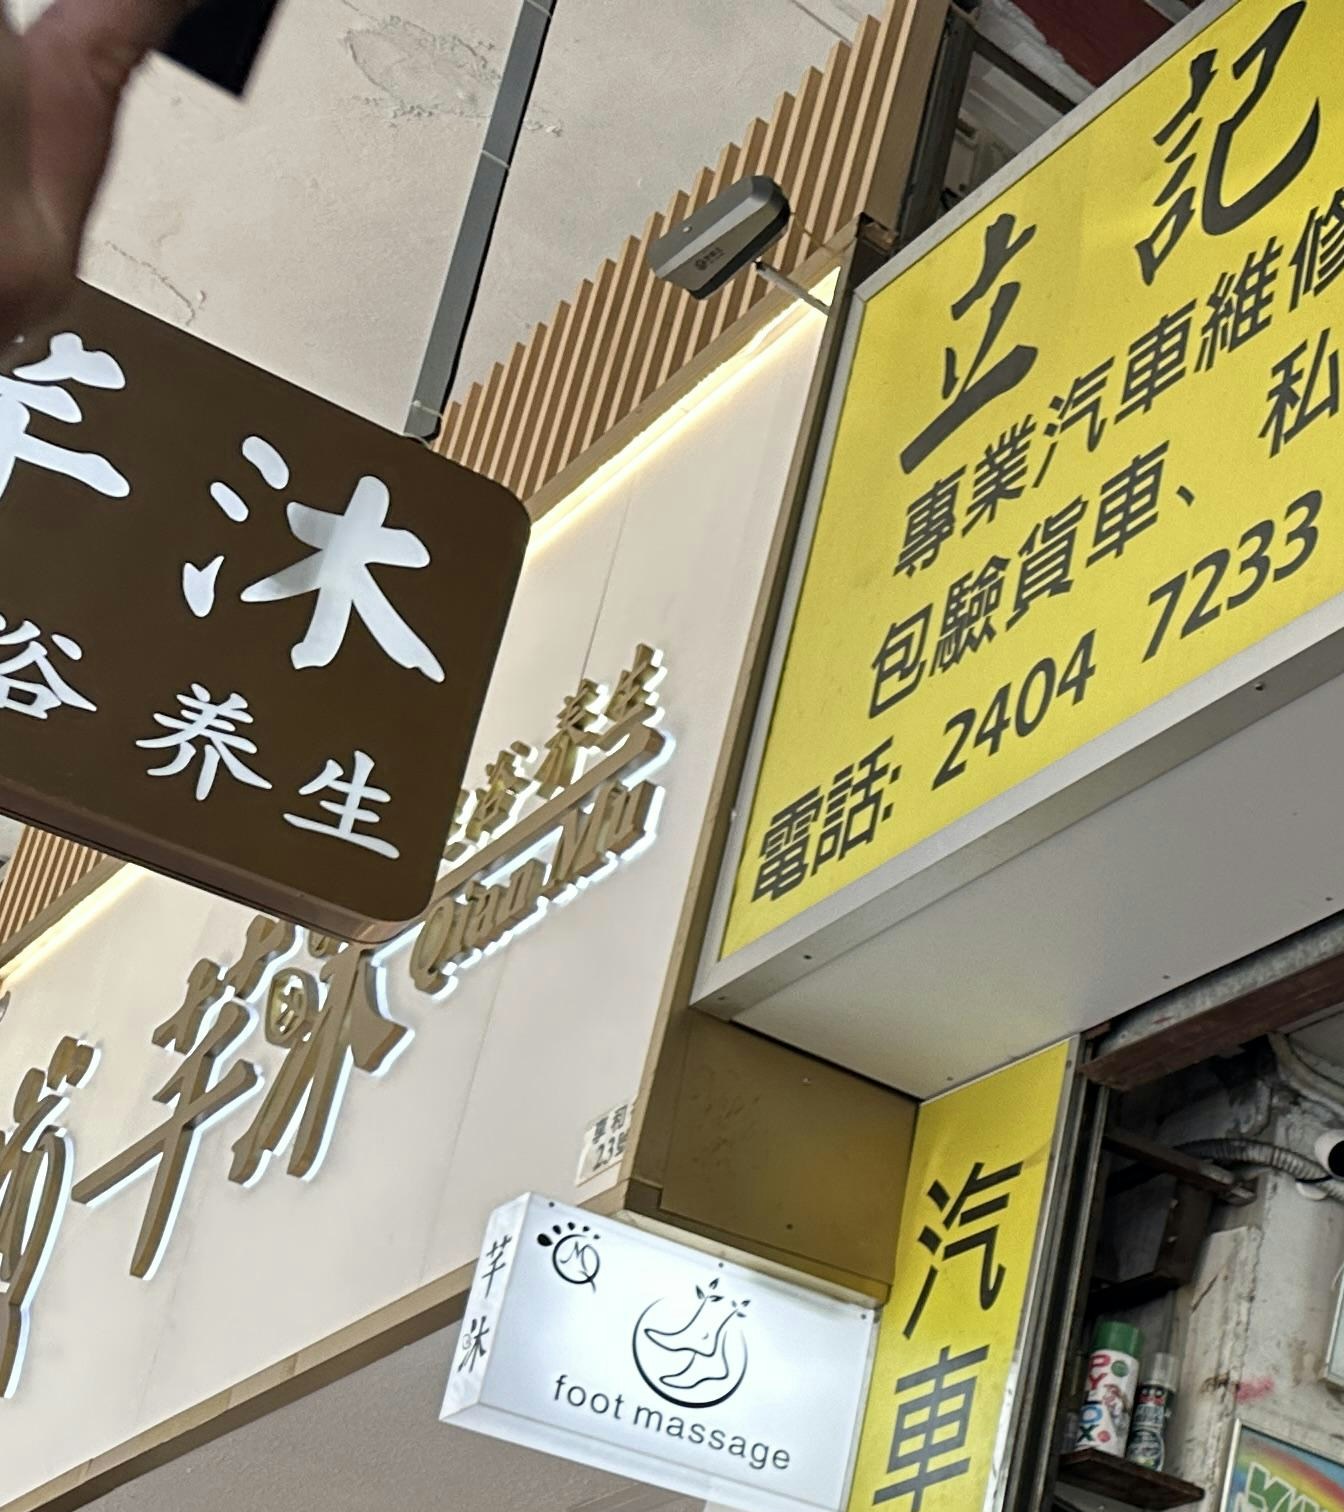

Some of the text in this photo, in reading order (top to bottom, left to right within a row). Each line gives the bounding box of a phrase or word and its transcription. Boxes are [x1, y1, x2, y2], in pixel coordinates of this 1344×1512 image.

[900, 0, 1322, 475] 立記
[931, 630, 1097, 792] 2404
[1143, 490, 1324, 663] 7233
[554, 1374, 793, 1472] foot massage
